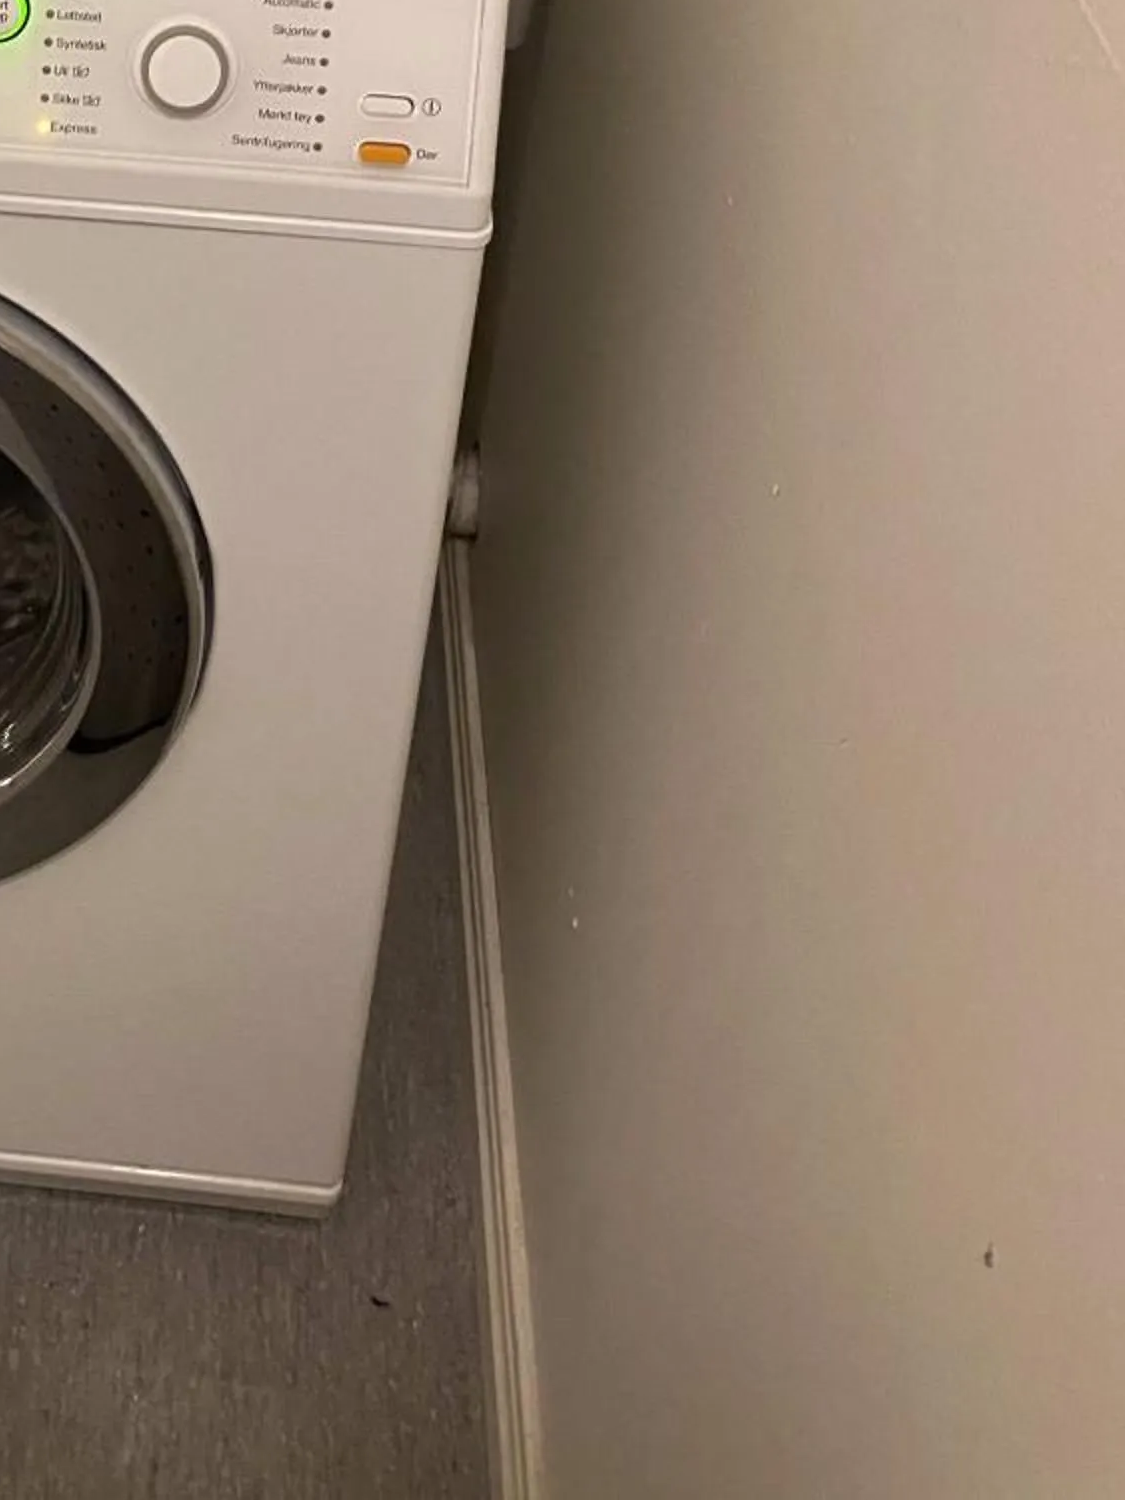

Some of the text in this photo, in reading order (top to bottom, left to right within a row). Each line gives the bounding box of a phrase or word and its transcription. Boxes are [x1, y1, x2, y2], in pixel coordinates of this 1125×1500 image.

[272, 24, 319, 38] Skjorter
[282, 54, 316, 67] Jeans
[50, 121, 97, 135] Express
[232, 134, 311, 152] Sentrifugering
